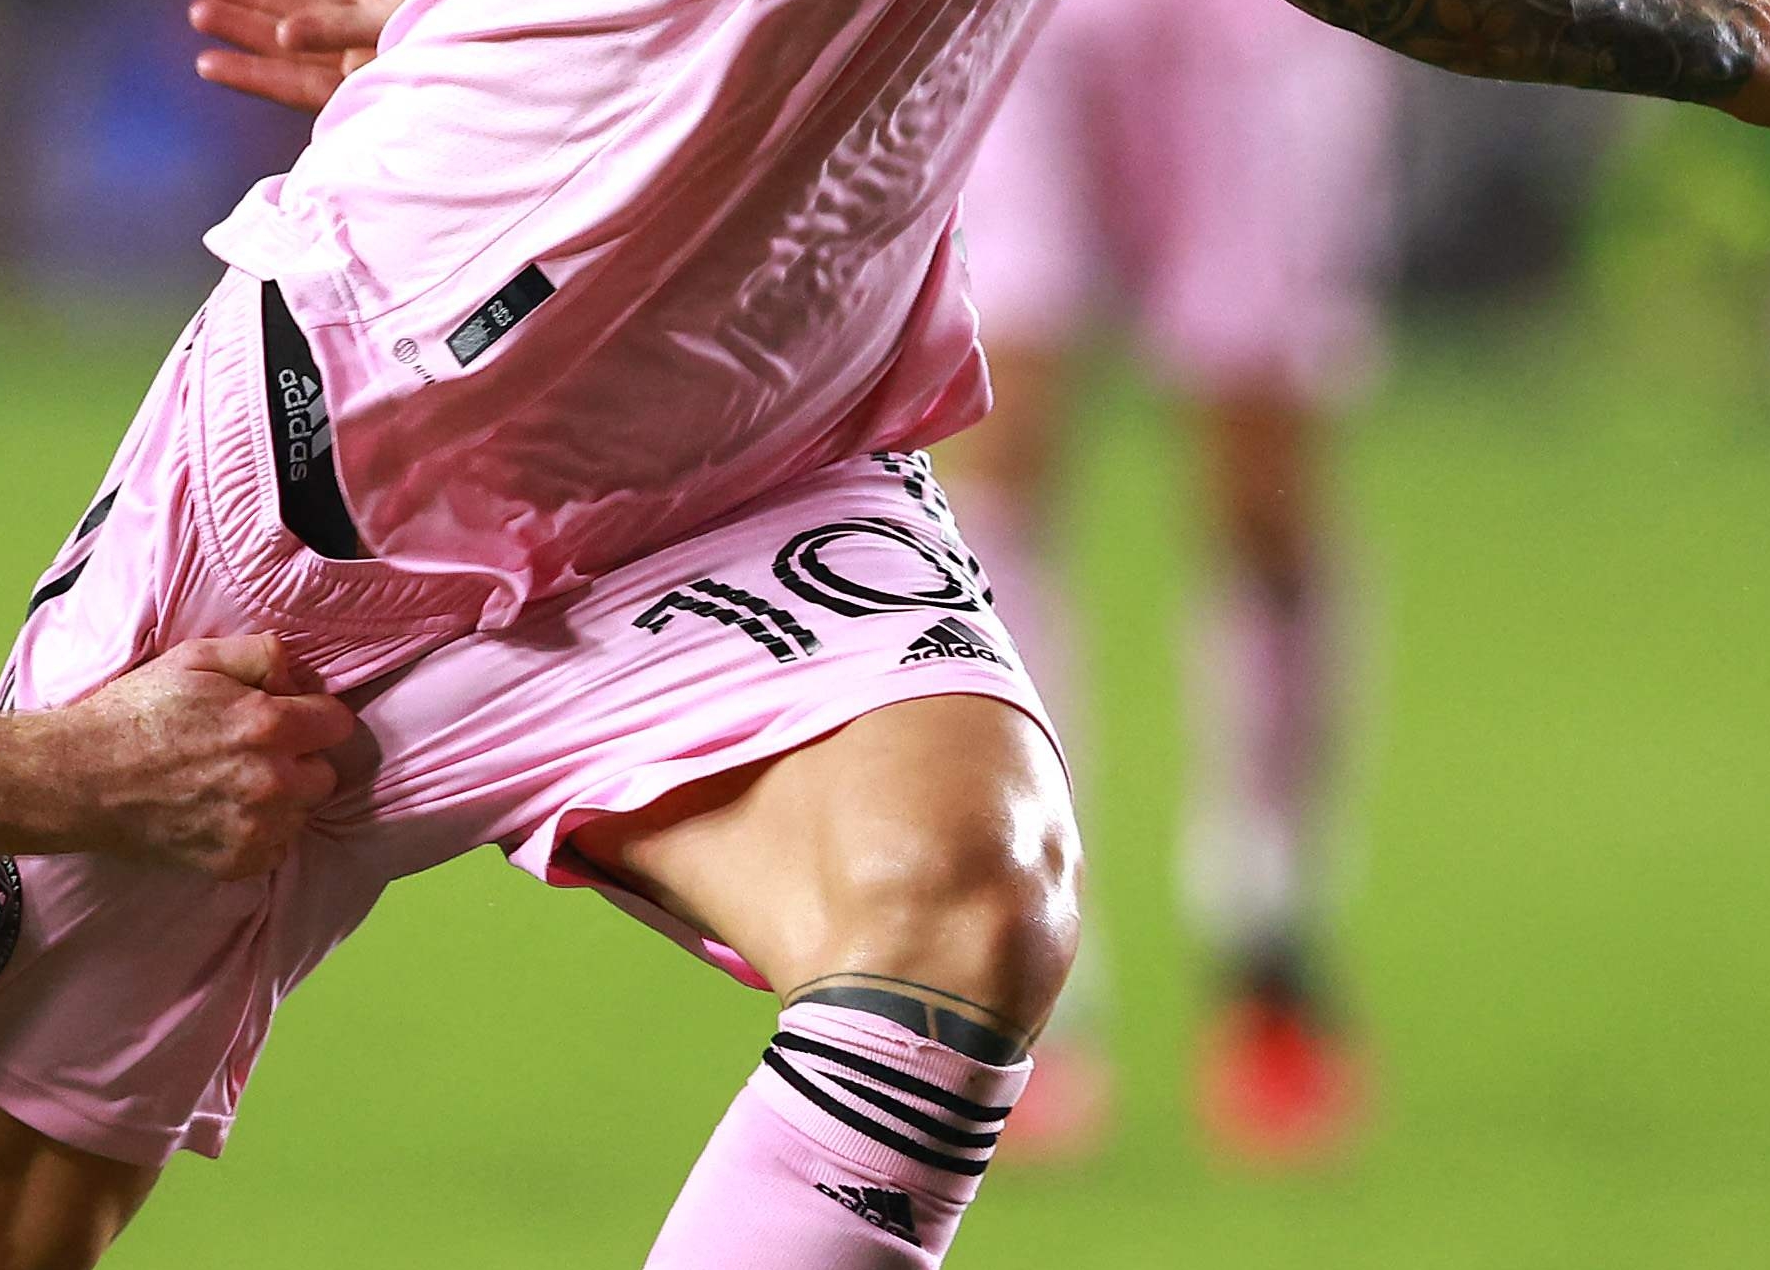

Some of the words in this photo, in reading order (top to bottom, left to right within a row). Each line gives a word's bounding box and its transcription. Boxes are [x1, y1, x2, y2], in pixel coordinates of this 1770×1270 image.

[278, 369, 313, 481] adidas
[632, 517, 980, 663] 10
[899, 642, 1013, 672] adida
